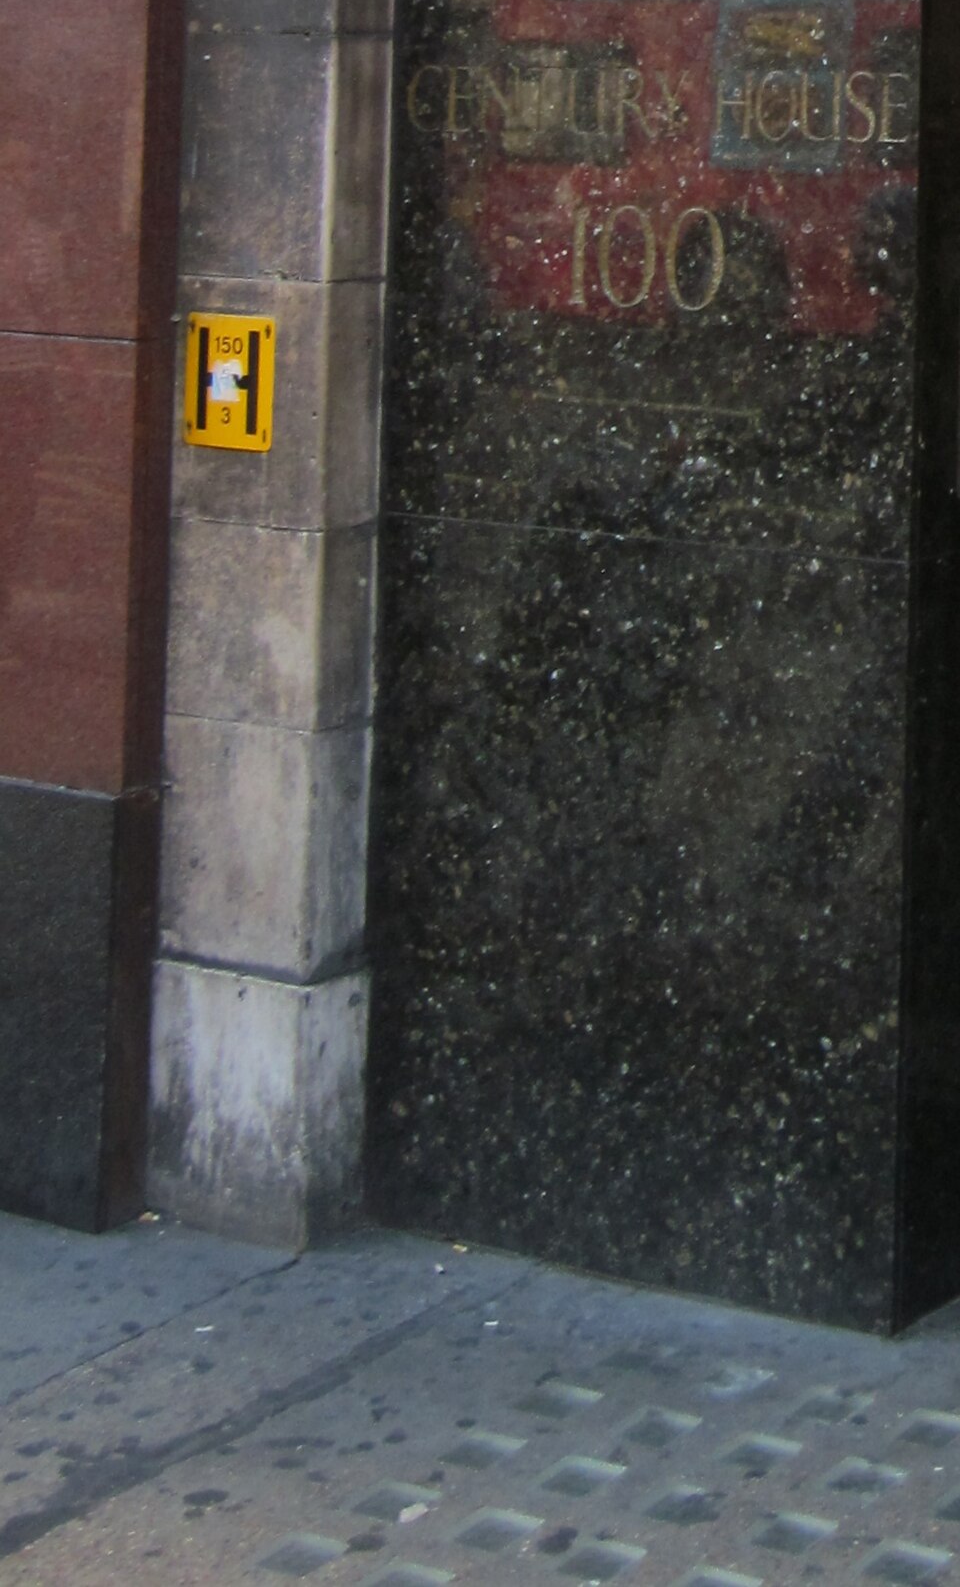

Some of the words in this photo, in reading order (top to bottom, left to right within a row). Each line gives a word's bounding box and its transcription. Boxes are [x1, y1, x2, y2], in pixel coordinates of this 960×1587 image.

[405, 65, 690, 138] CENTURY
[716, 69, 911, 145] HOUSE
[568, 204, 727, 312] 100
[214, 335, 244, 355] 150
[220, 407, 231, 424] 3
